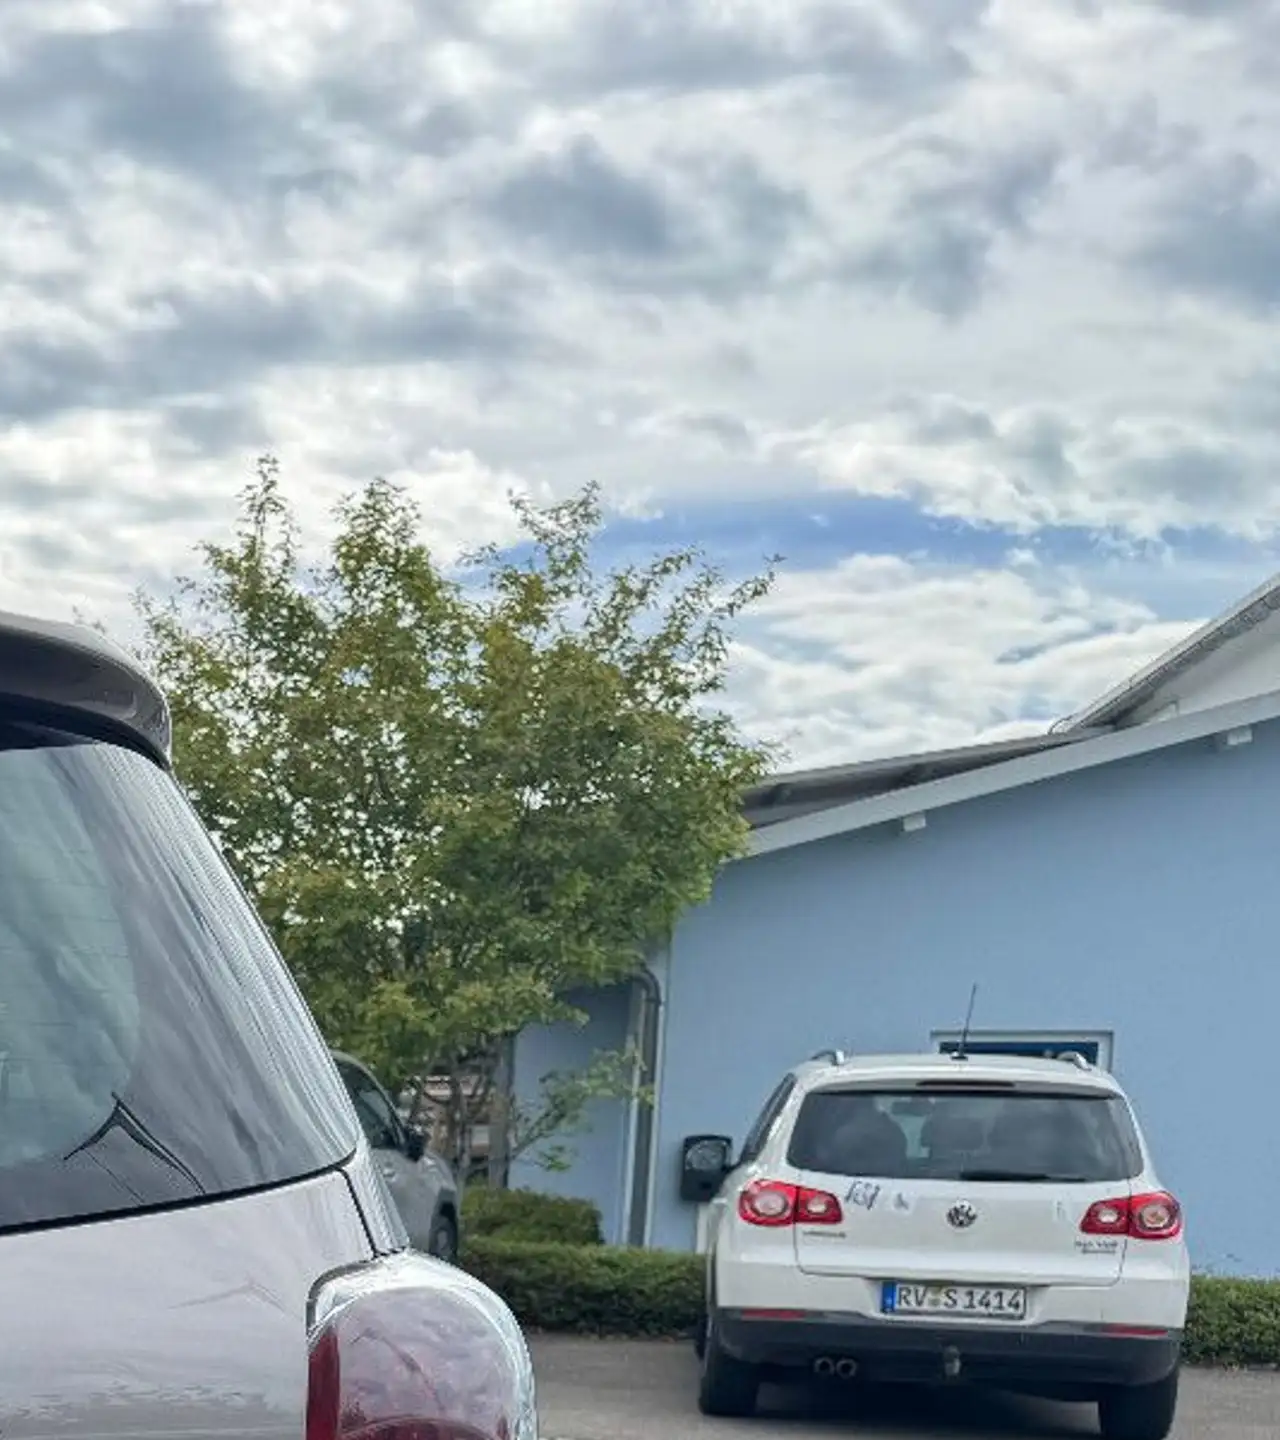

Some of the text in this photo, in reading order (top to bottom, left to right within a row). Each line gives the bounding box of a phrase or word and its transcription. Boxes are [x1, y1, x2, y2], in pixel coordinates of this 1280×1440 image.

[898, 1286, 1021, 1311] RV S 1414
